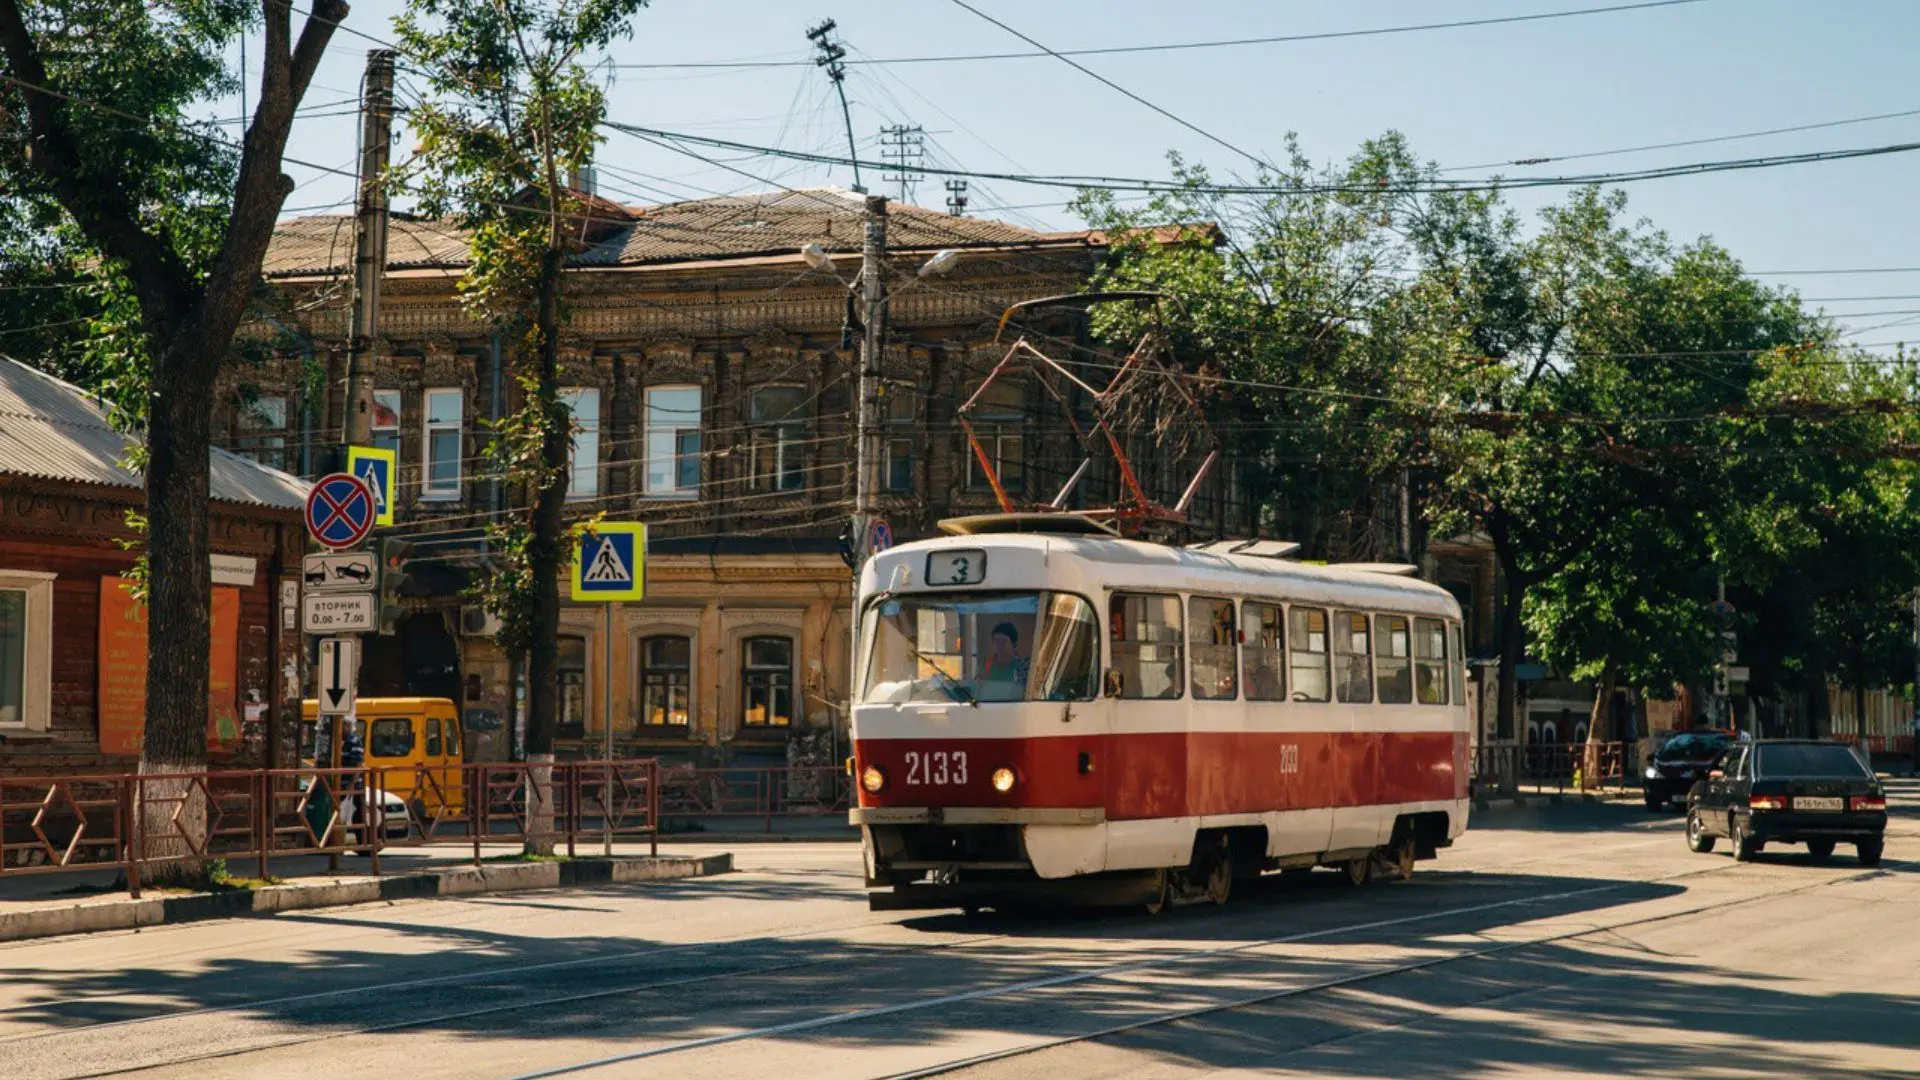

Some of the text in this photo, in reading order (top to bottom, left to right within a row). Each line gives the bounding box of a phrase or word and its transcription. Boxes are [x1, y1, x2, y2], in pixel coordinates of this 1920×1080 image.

[952, 557, 969, 584] 3
[285, 587, 295, 600] 47
[314, 601, 361, 611] ВТОРНИК
[312, 613, 333, 624] 0.00
[344, 611, 365, 623] 7.00
[905, 751, 968, 785] 2133
